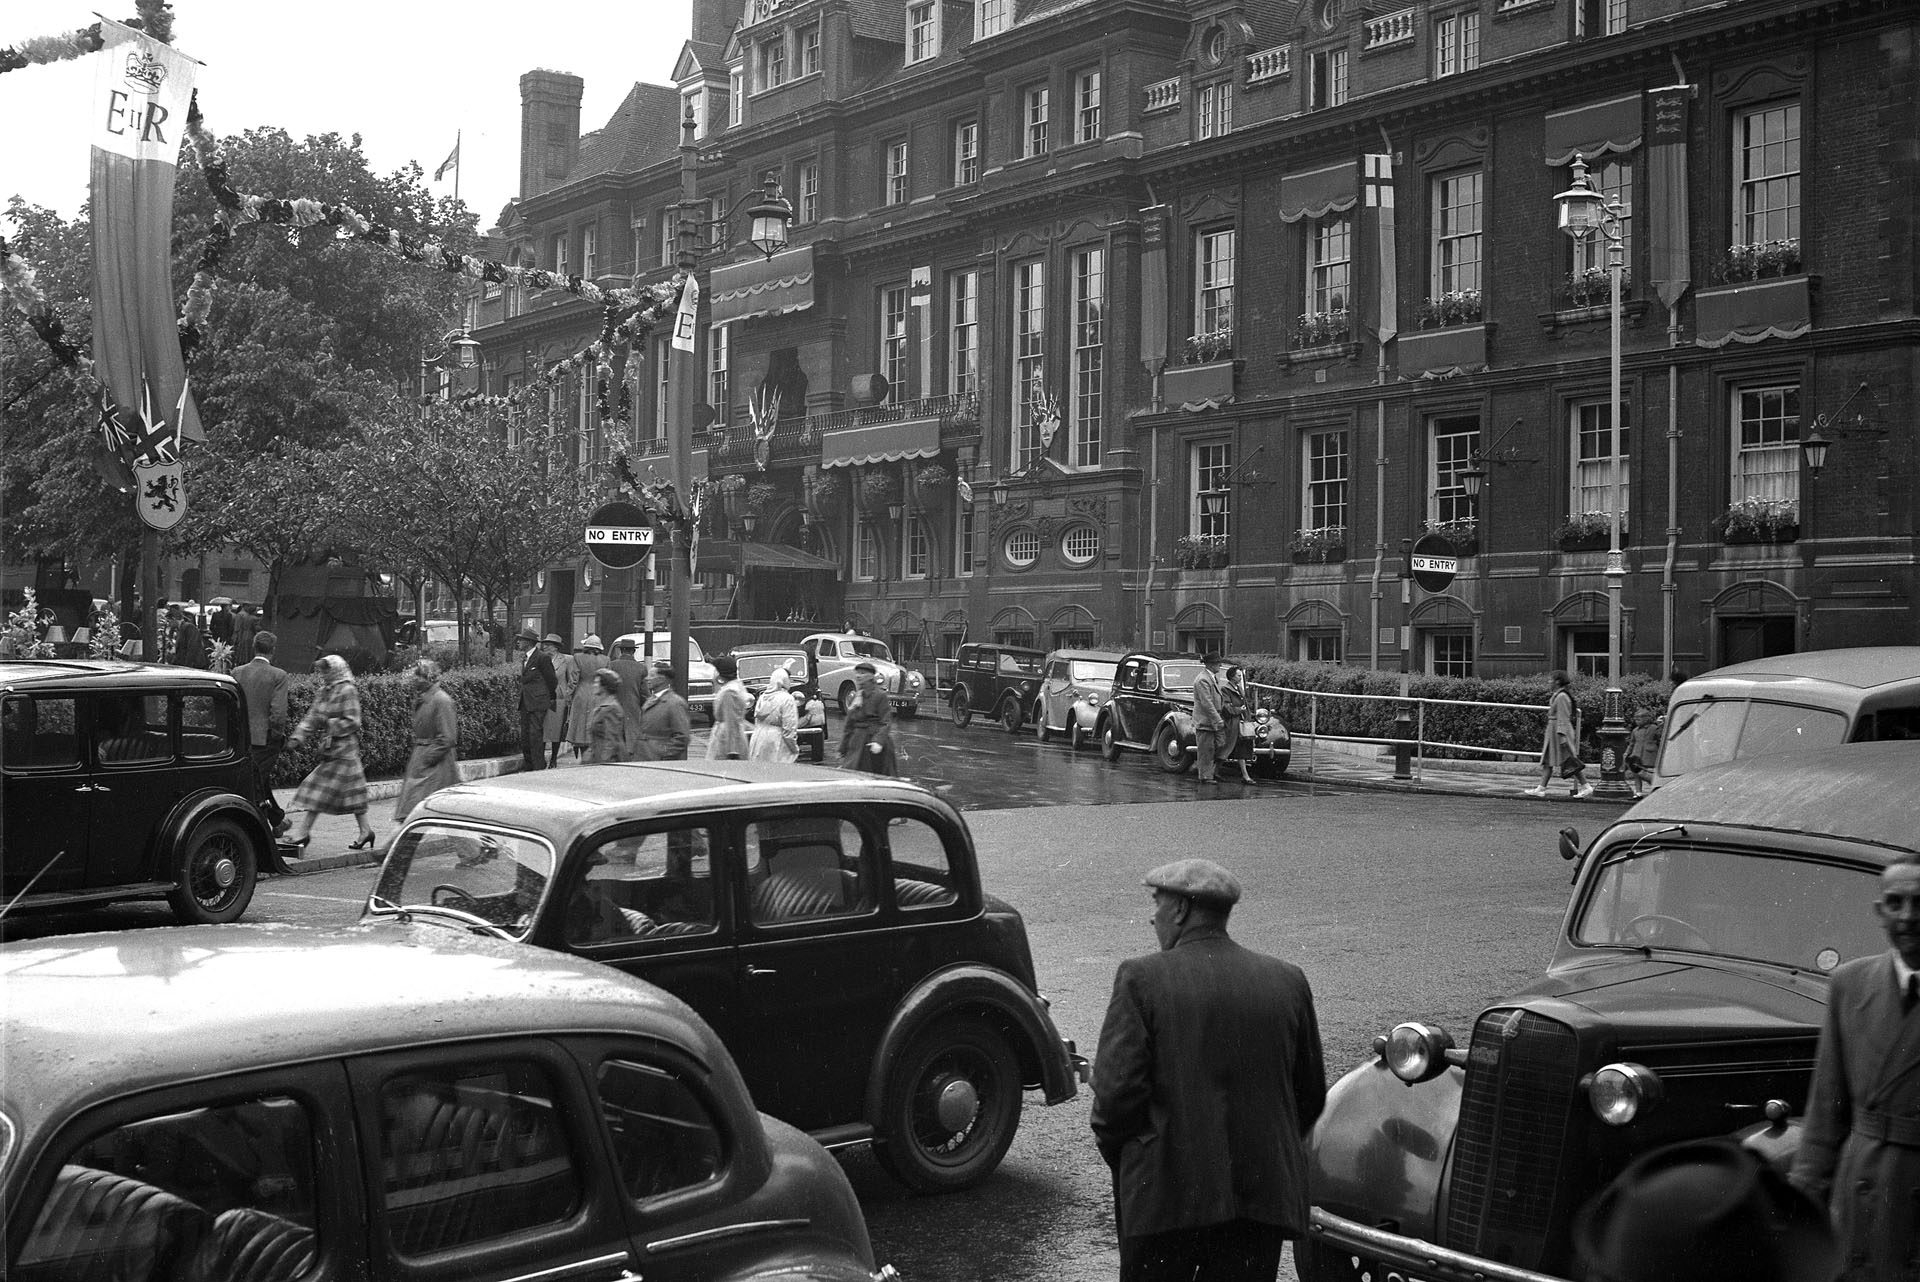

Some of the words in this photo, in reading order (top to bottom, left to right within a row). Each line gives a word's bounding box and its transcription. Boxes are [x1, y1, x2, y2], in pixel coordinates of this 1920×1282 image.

[588, 530, 605, 540] NO
[612, 531, 649, 541] ENTRY
[1413, 559, 1425, 568] NO
[1429, 560, 1456, 570] ENTRY
